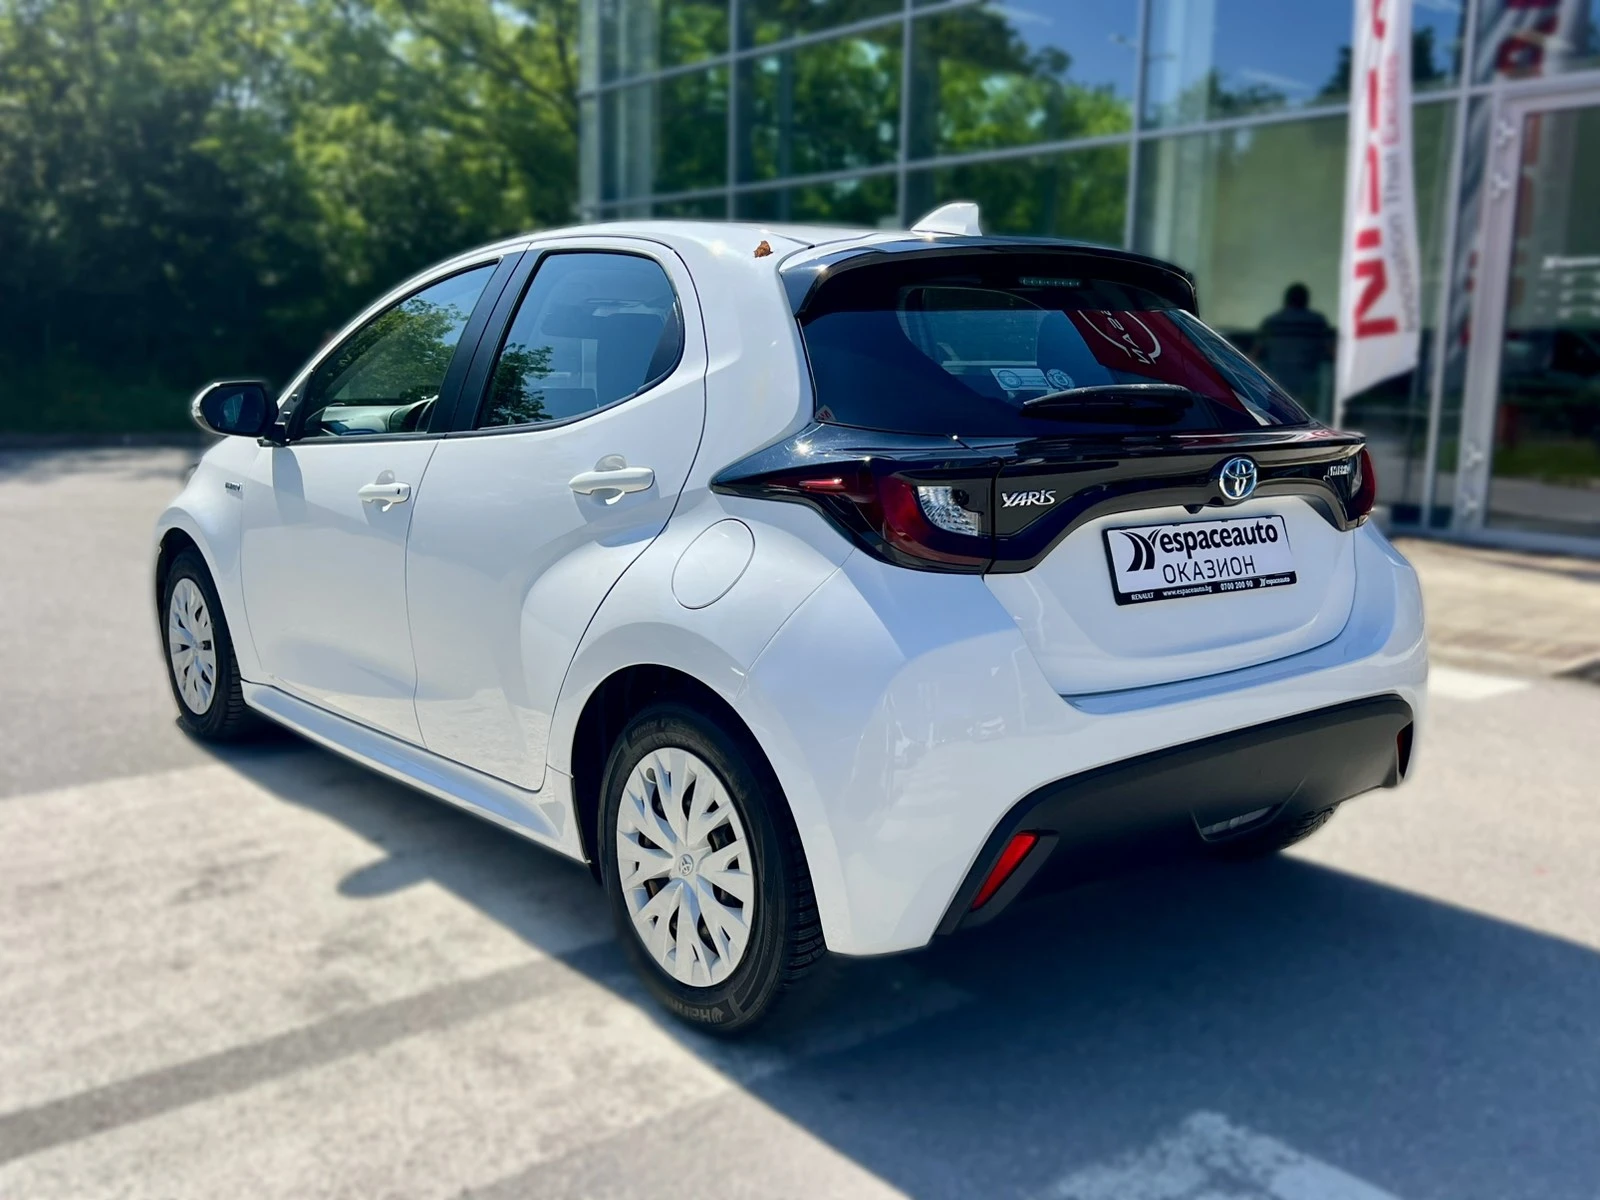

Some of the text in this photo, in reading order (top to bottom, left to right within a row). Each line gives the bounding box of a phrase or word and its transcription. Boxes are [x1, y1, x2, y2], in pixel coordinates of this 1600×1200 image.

[1001, 489, 1056, 508] YARIS
[1159, 520, 1278, 559] espaceauto
[1162, 554, 1256, 584] ОКАЗИОН
[1131, 591, 1154, 601] RENAULT
[1162, 584, 1213, 597] www.espaceauto.bg
[1220, 580, 1235, 591] 0700
[1266, 576, 1291, 585] espaceauto
